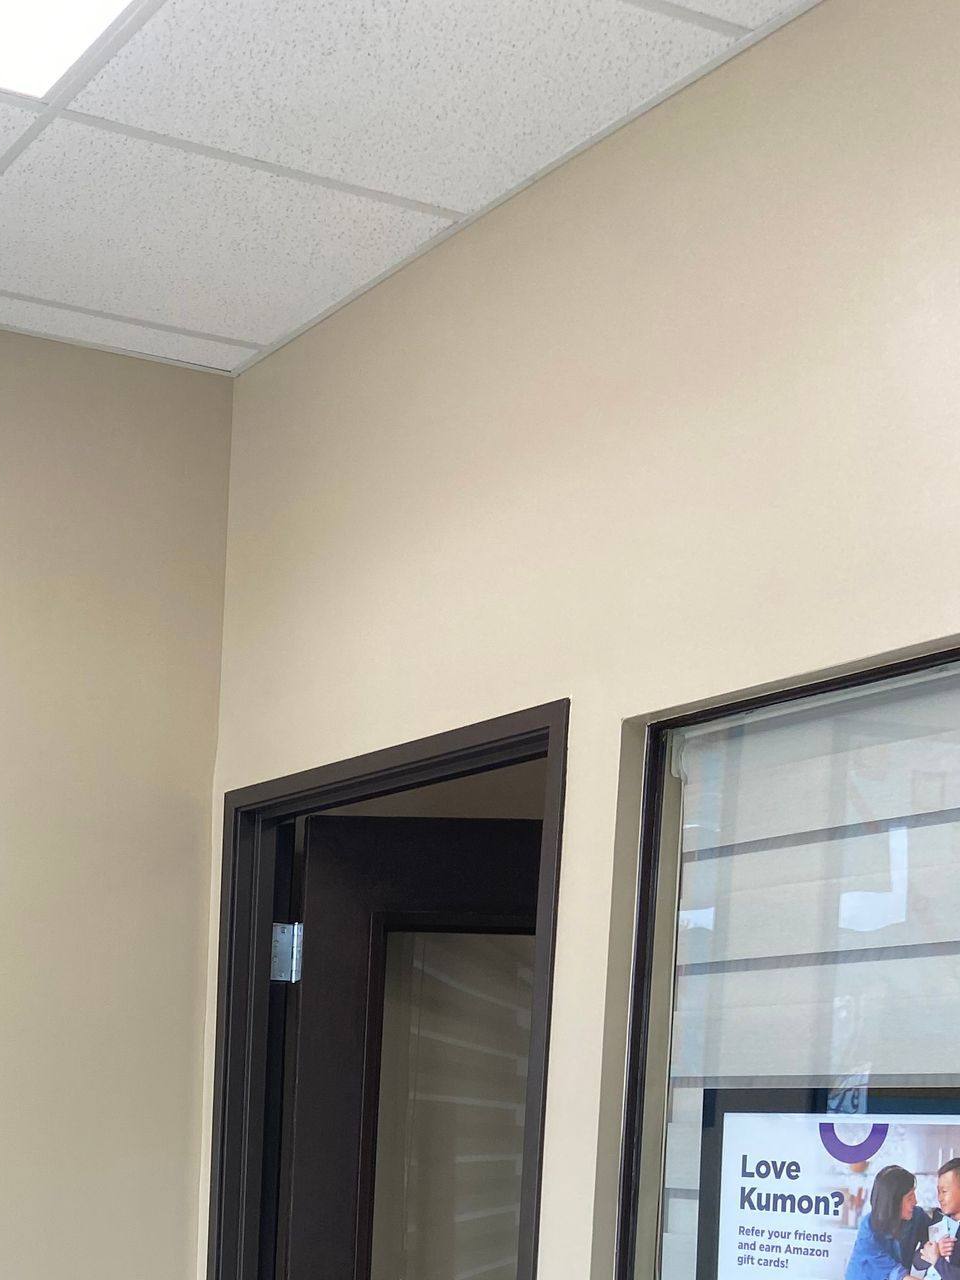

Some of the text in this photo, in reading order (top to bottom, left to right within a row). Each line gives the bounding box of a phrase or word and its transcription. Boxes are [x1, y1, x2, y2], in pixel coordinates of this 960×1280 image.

[741, 1154, 801, 1180] Love
[740, 1186, 845, 1216] Kumon?
[738, 1226, 833, 1243] Refer your friends
[737, 1241, 830, 1258] and earn Amazon
[737, 1255, 789, 1269] gift cards!
